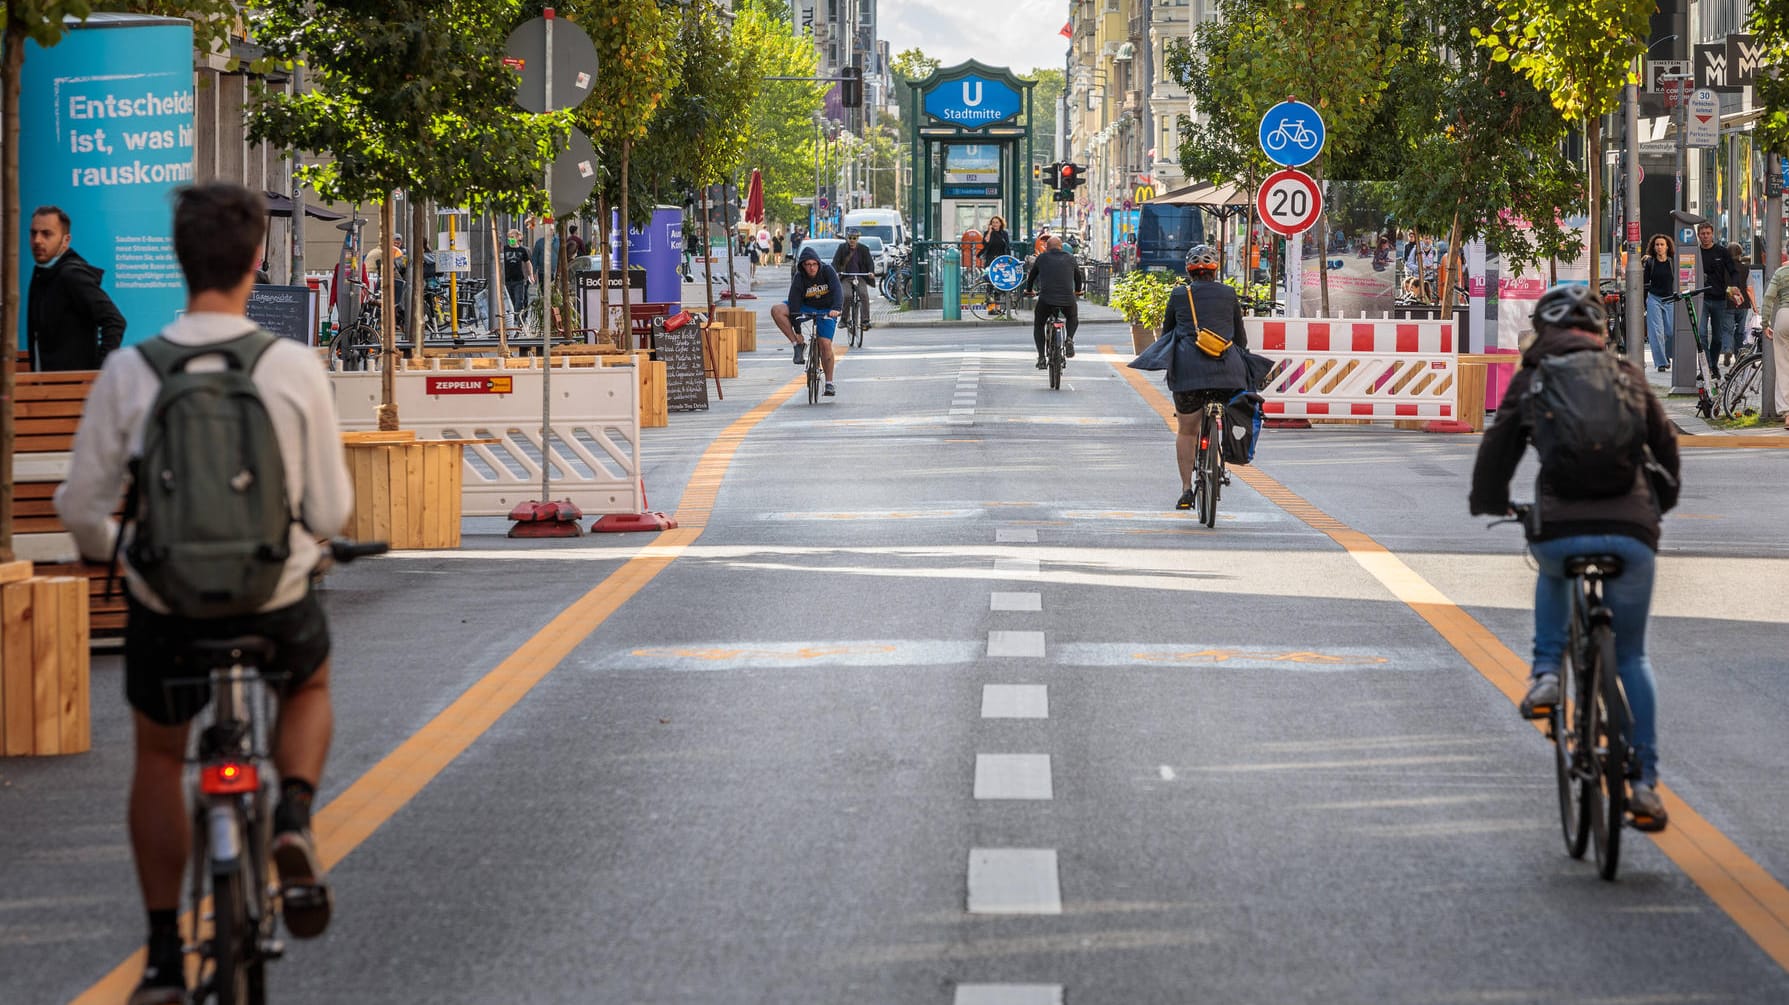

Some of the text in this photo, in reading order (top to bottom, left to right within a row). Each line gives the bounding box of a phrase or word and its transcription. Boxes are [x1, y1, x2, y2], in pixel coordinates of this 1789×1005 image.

[962, 81, 982, 107] U
[1699, 92, 1710, 100] 30
[944, 108, 1002, 119] Stadtmitte
[70, 128, 113, 155] ist,
[122, 129, 174, 150] was
[1271, 189, 1307, 217] 20
[1683, 229, 1694, 244] P
[435, 381, 482, 389] ZEPPELIN
